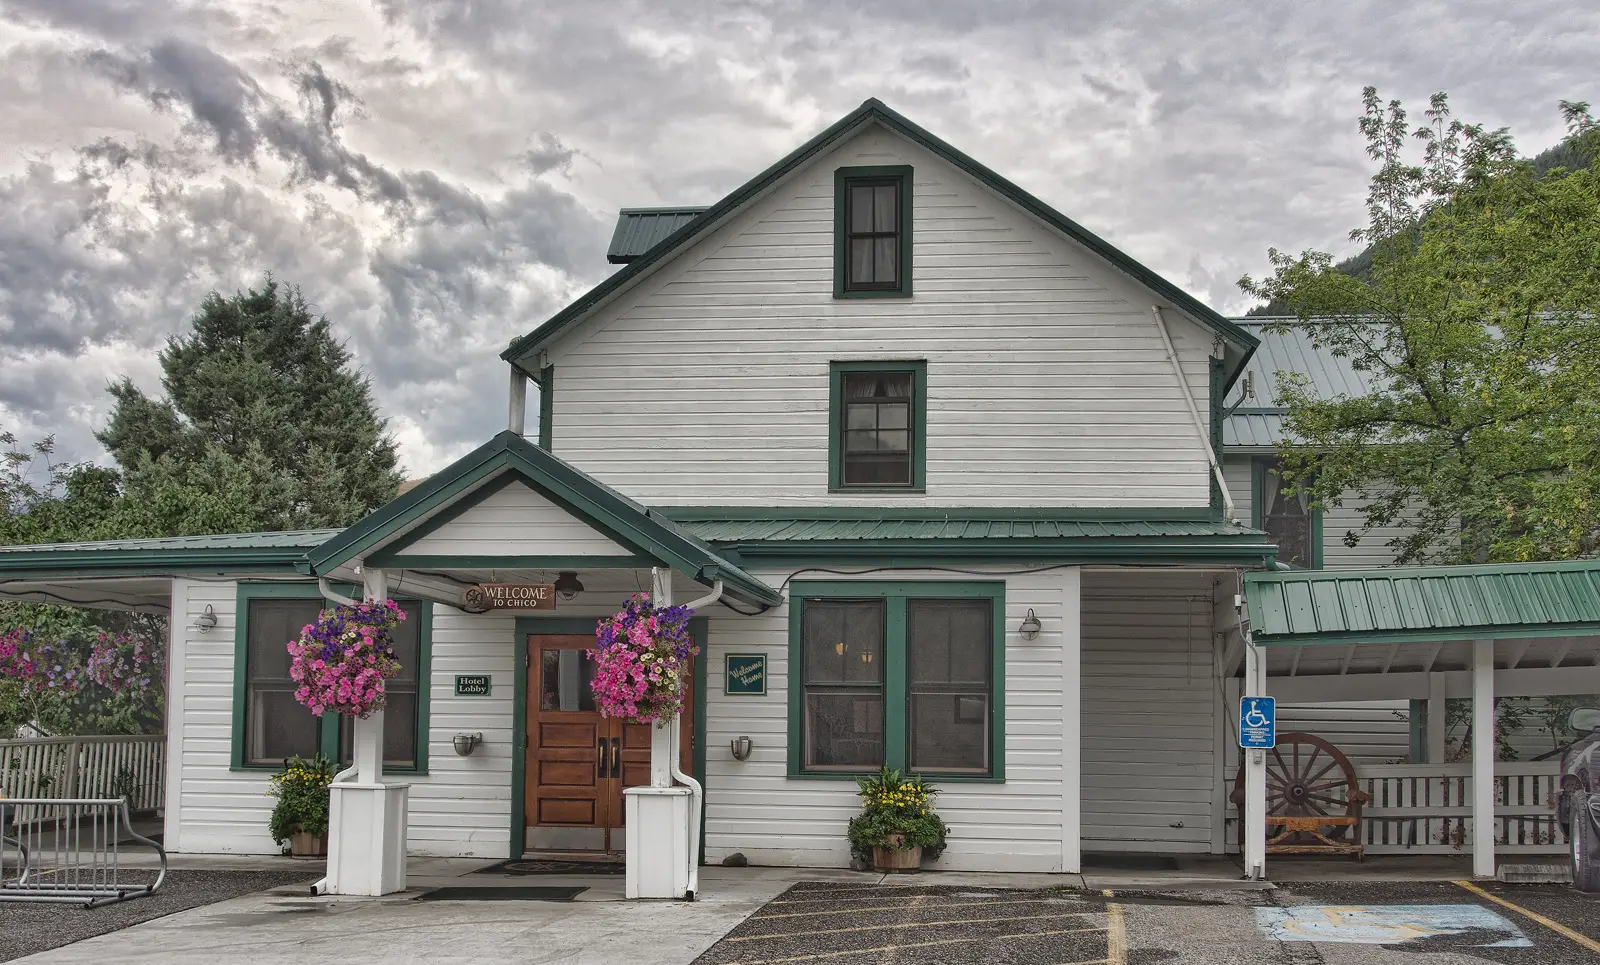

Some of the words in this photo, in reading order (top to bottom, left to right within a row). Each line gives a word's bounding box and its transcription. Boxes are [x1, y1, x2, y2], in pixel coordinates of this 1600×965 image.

[484, 587, 547, 600] WELCOME
[493, 599, 504, 607] TO
[507, 599, 537, 607] CHICO
[729, 660, 763, 679] Welcome
[460, 677, 485, 685] Hotel
[740, 672, 763, 687] Home
[459, 685, 486, 694] Lobby
